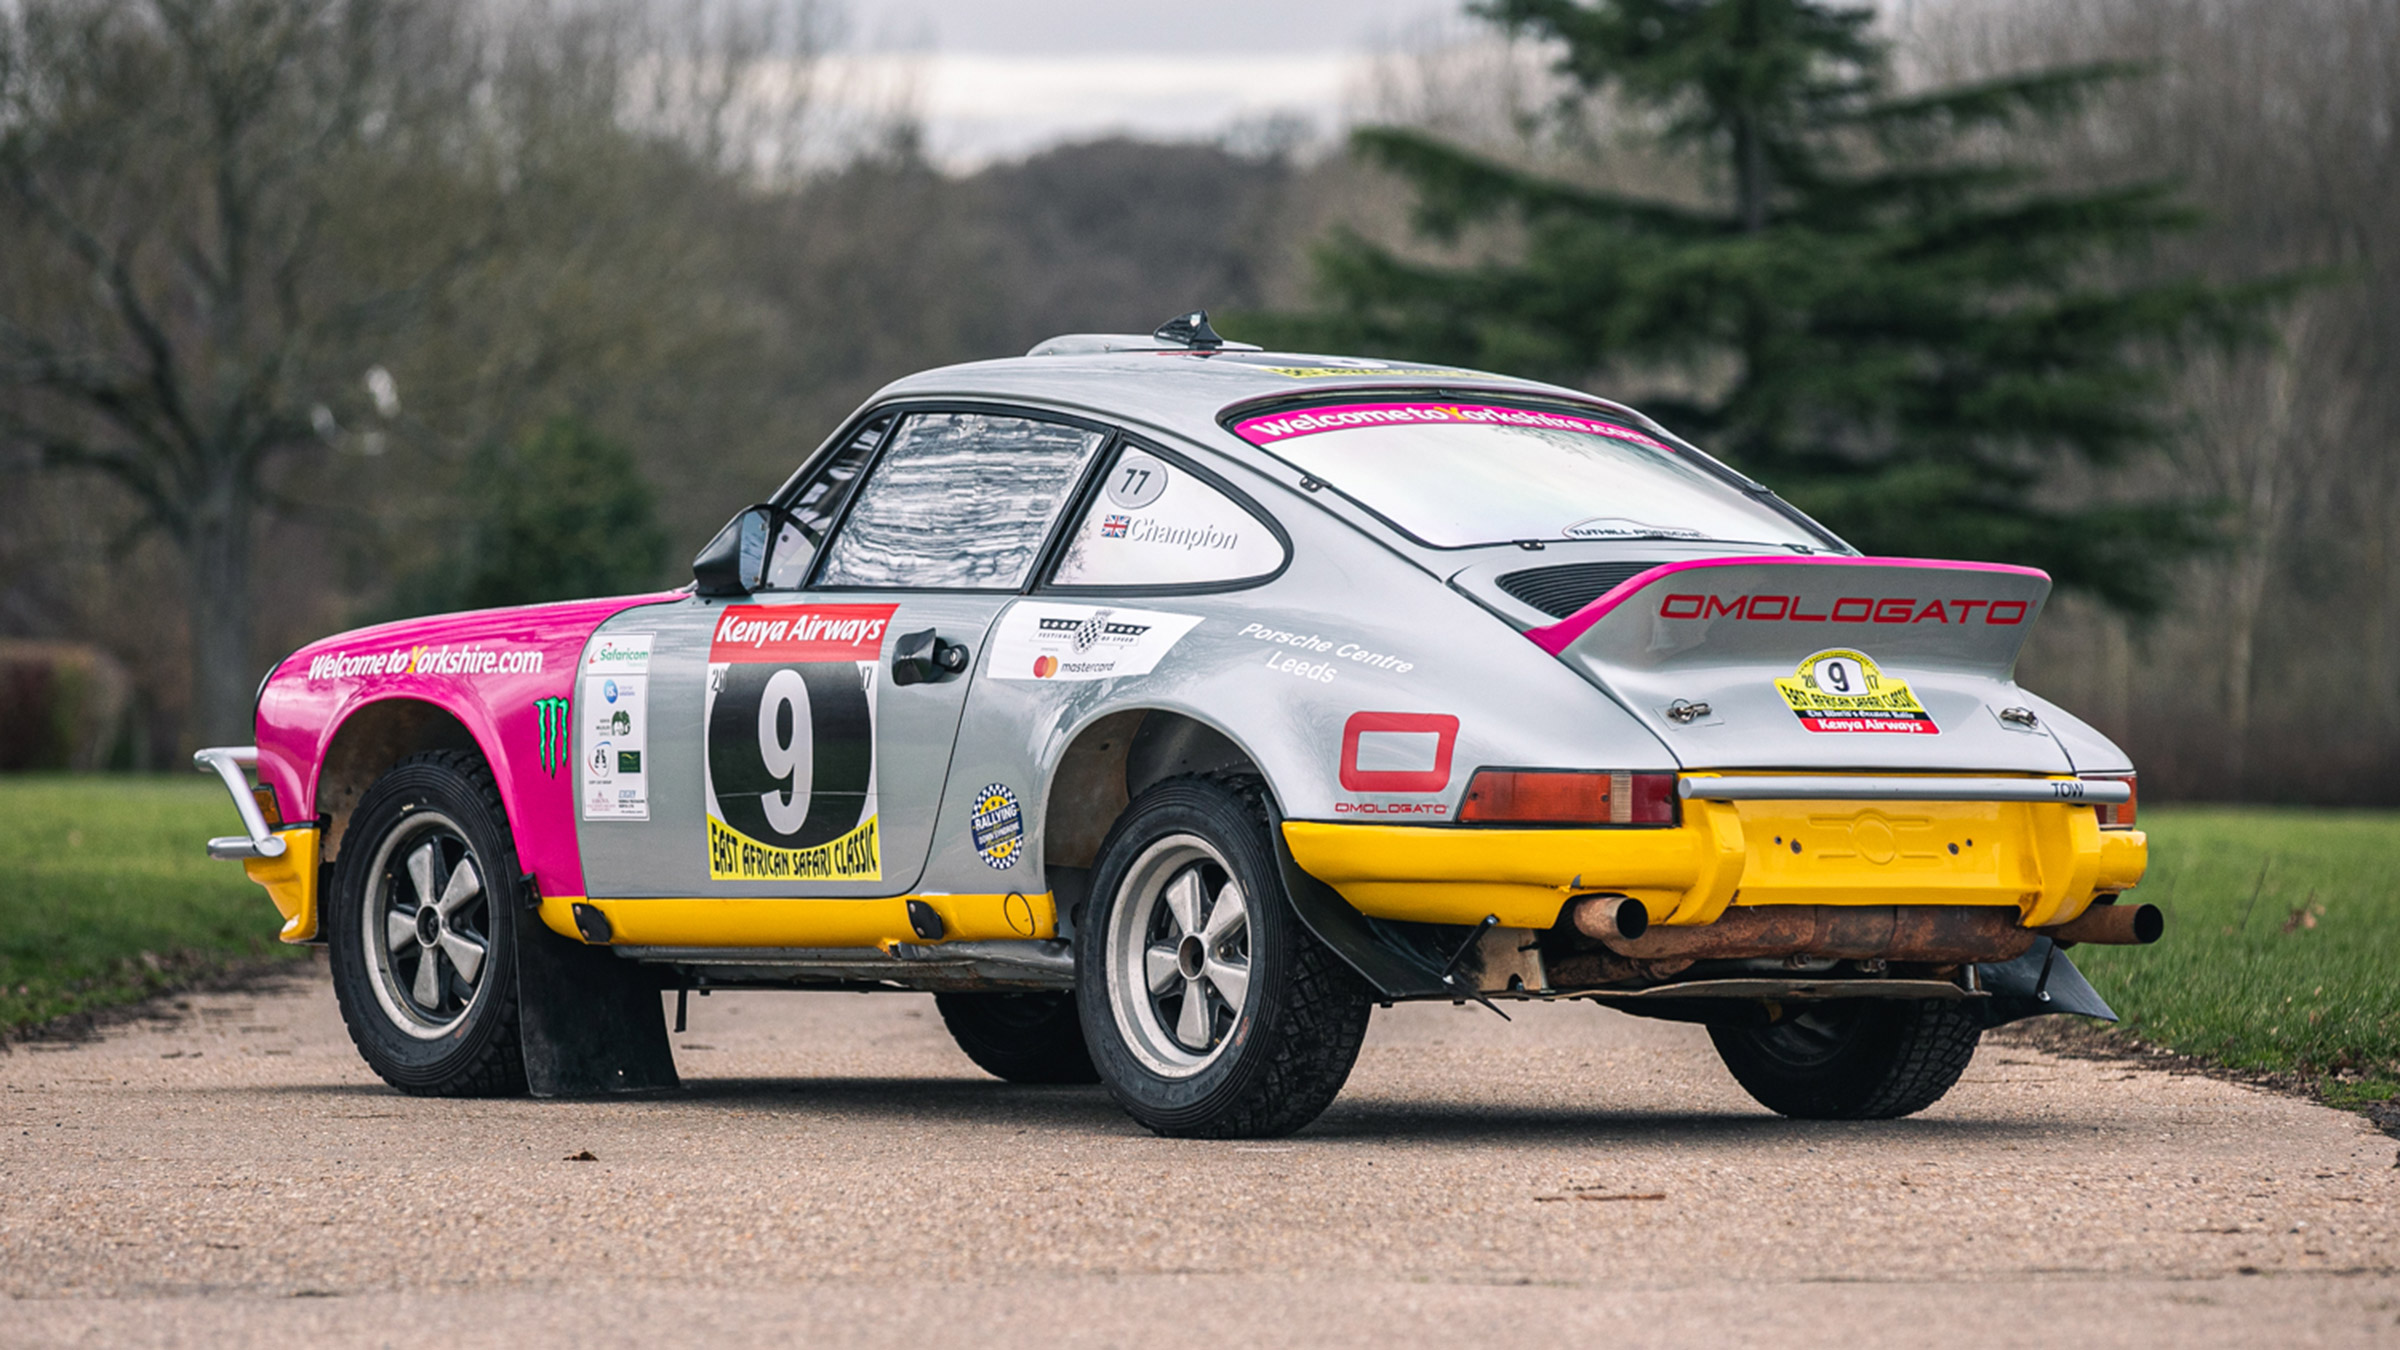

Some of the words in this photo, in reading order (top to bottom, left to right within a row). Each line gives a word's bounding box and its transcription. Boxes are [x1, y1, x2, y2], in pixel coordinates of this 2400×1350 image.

[1120, 468, 1152, 495] 77
[1131, 518, 1239, 551] Champion
[1660, 593, 2027, 626] OMOLOGATO
[716, 616, 789, 648] Kenya
[786, 614, 886, 647] Airways
[599, 648, 649, 662] Safaricom
[1238, 622, 1333, 653] Porsche
[1336, 643, 1414, 673] Centre
[1061, 660, 1116, 673] mastercard
[1265, 650, 1338, 684] Leeds
[1828, 661, 1850, 692] 9
[1816, 718, 1865, 733] Kenya
[1864, 719, 1924, 734] Airways
[758, 669, 814, 835] 9
[2050, 782, 2084, 798] TOW
[974, 804, 1018, 832] RALLYING
[1334, 802, 1448, 815] OMOLOGATO
[711, 822, 738, 876] EAST
[742, 842, 790, 877] AFRICAN
[792, 845, 831, 877] SAFARI
[834, 822, 877, 876] CLASSIC
